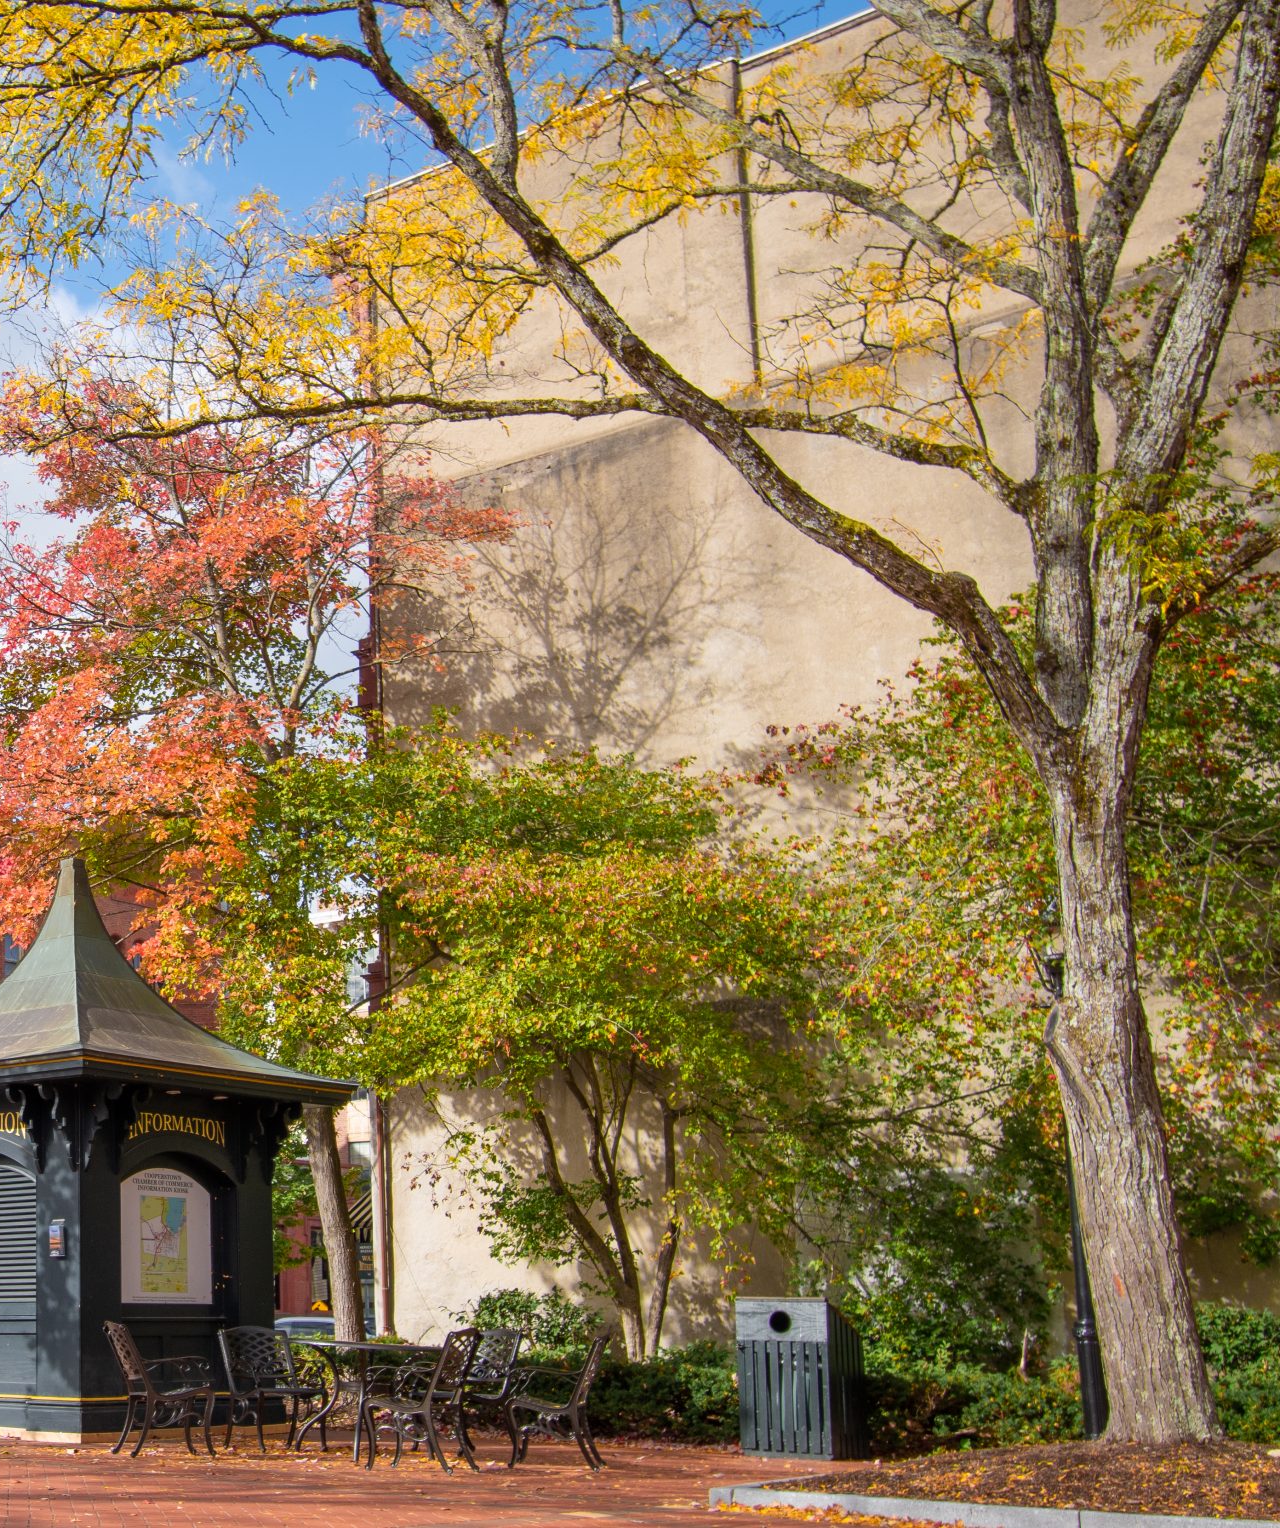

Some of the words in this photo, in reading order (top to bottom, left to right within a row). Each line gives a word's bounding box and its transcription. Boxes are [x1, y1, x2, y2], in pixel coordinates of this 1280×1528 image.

[128, 1111, 225, 1147] INFORMATION
[144, 1172, 182, 1180] COOPERSTOWN
[132, 1177, 157, 1186] CHAMBER
[165, 1180, 193, 1188] COMMERCE
[137, 1184, 173, 1193] INFORMATION
